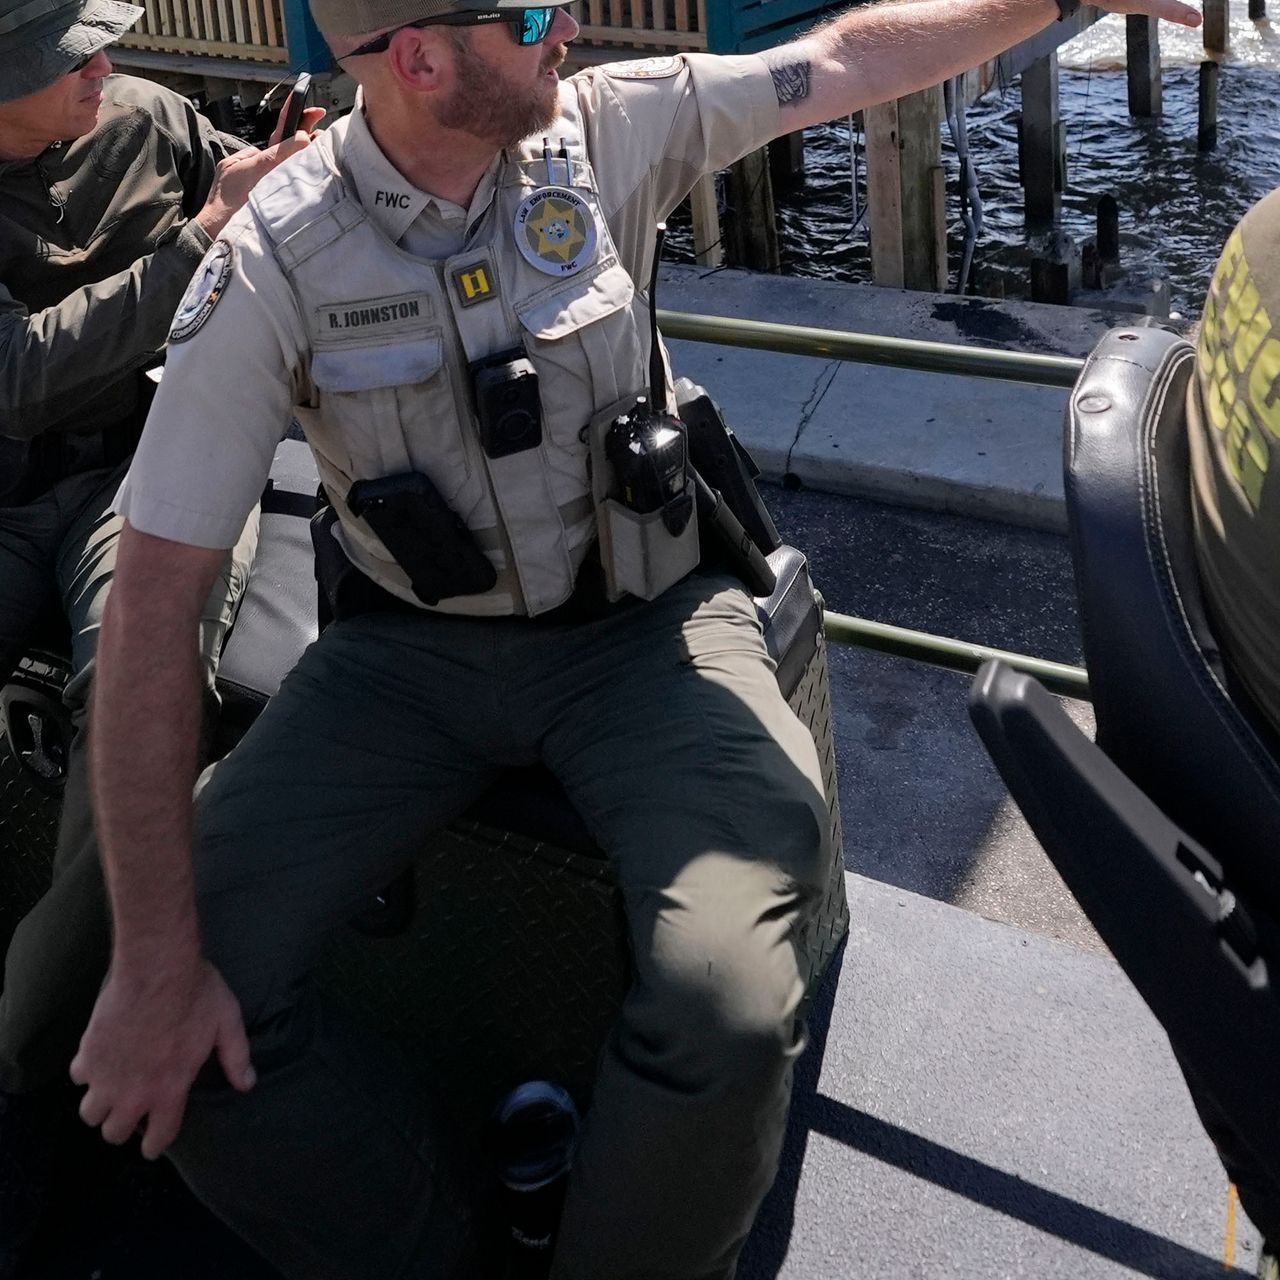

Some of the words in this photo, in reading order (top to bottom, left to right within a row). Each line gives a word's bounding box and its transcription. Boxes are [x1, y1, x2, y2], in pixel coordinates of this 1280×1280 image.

[375, 190, 410, 209] FWC
[519, 207, 529, 224] LAW
[529, 191, 581, 207] ENFORCEMENT
[561, 260, 578, 272] FWC
[344, 300, 420, 328] JOHNSTON
